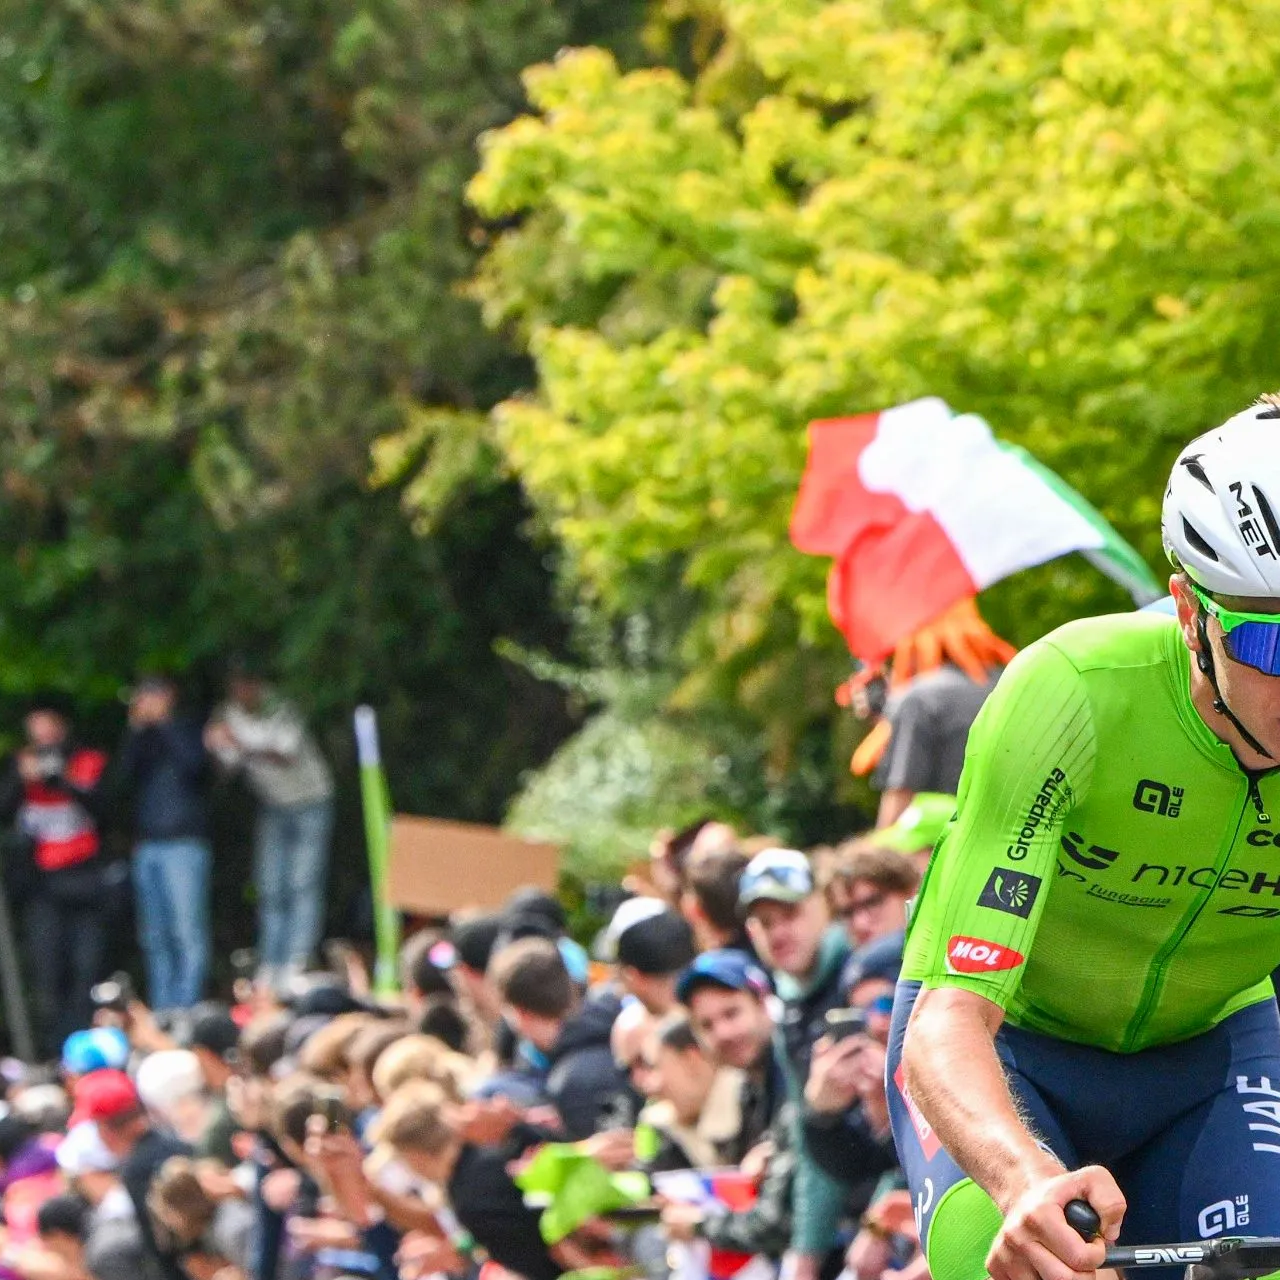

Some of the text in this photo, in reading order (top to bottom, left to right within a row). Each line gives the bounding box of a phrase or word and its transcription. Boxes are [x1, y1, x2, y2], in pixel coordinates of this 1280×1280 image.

[1229, 481, 1277, 560] MET
[1007, 767, 1066, 861] Groupama
[951, 941, 1001, 966] MOL
